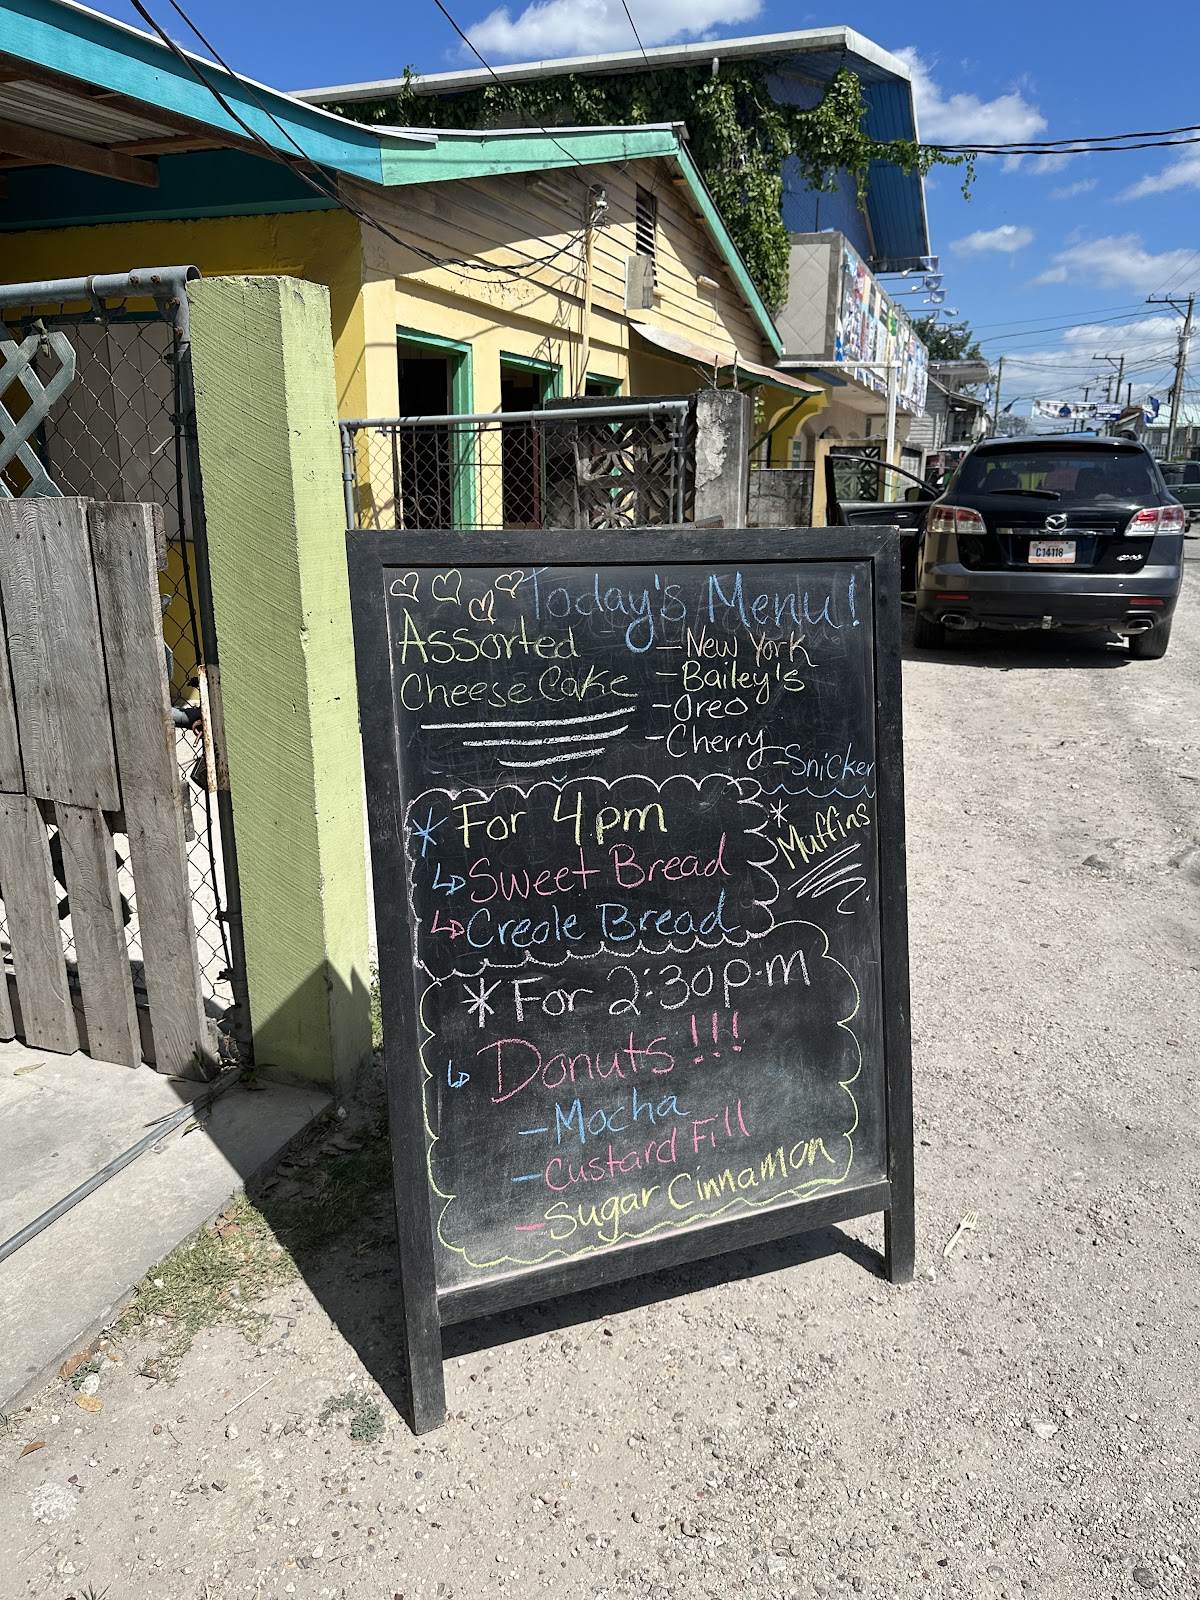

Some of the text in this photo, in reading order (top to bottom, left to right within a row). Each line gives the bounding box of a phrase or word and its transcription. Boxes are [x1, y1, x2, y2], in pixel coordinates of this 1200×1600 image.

[398, 608, 581, 665] Assorted
[522, 567, 686, 653] Today's
[749, 630, 819, 667] York
[400, 665, 638, 711] Cheese Cake
[455, 802, 527, 848] For
[776, 802, 871, 870] Muffins
[468, 832, 732, 903] Sweet Bread
[466, 889, 740, 949] Creole Bread
[511, 977, 594, 1022] For
[692, 1099, 751, 1153] Fill
[668, 1134, 835, 1210] Cinnamon
